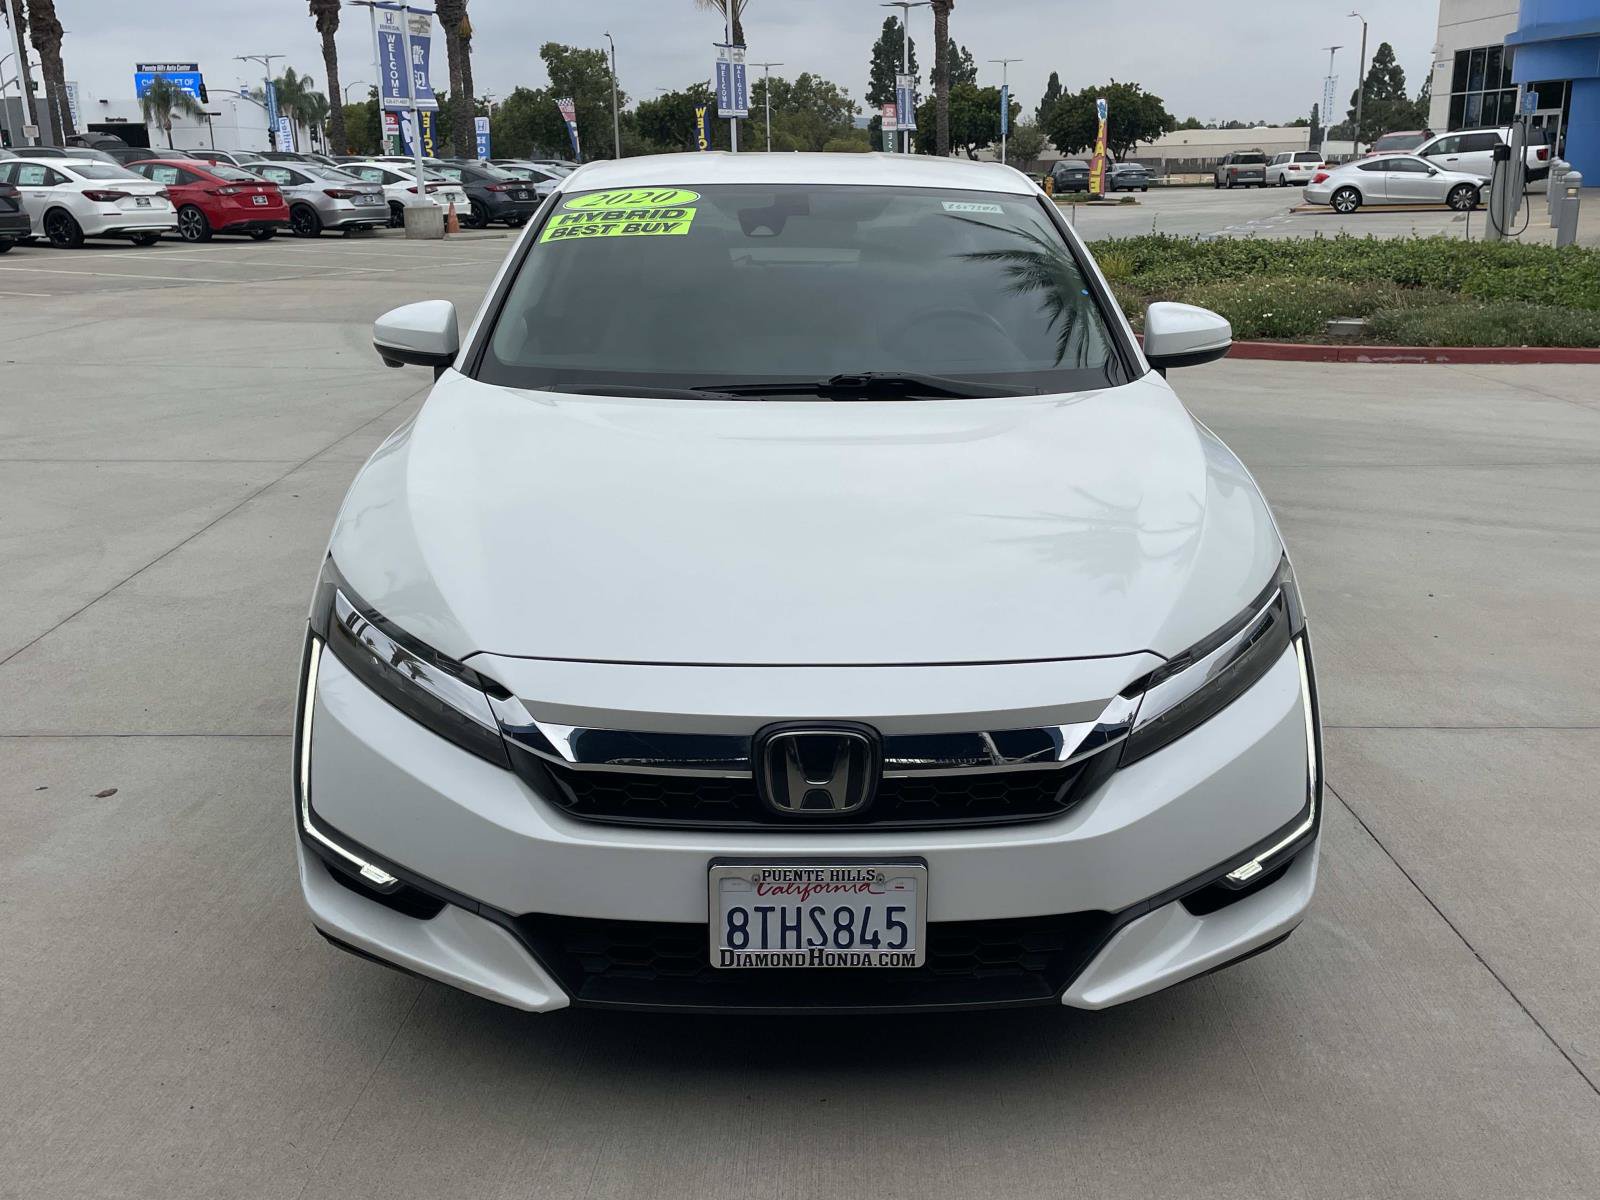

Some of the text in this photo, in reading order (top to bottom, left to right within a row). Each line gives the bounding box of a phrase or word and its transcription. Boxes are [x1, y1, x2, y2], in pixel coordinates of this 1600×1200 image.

[384, 33, 400, 97] WELCOME
[582, 191, 678, 207] 2020
[558, 209, 687, 225] HYBRID
[548, 222, 681, 240] BEST BUY
[761, 869, 876, 882] PUENTE HILLS
[757, 881, 887, 902] California
[726, 906, 909, 950] 8THS845
[719, 949, 917, 968] DIAMONDHONDA.COM
